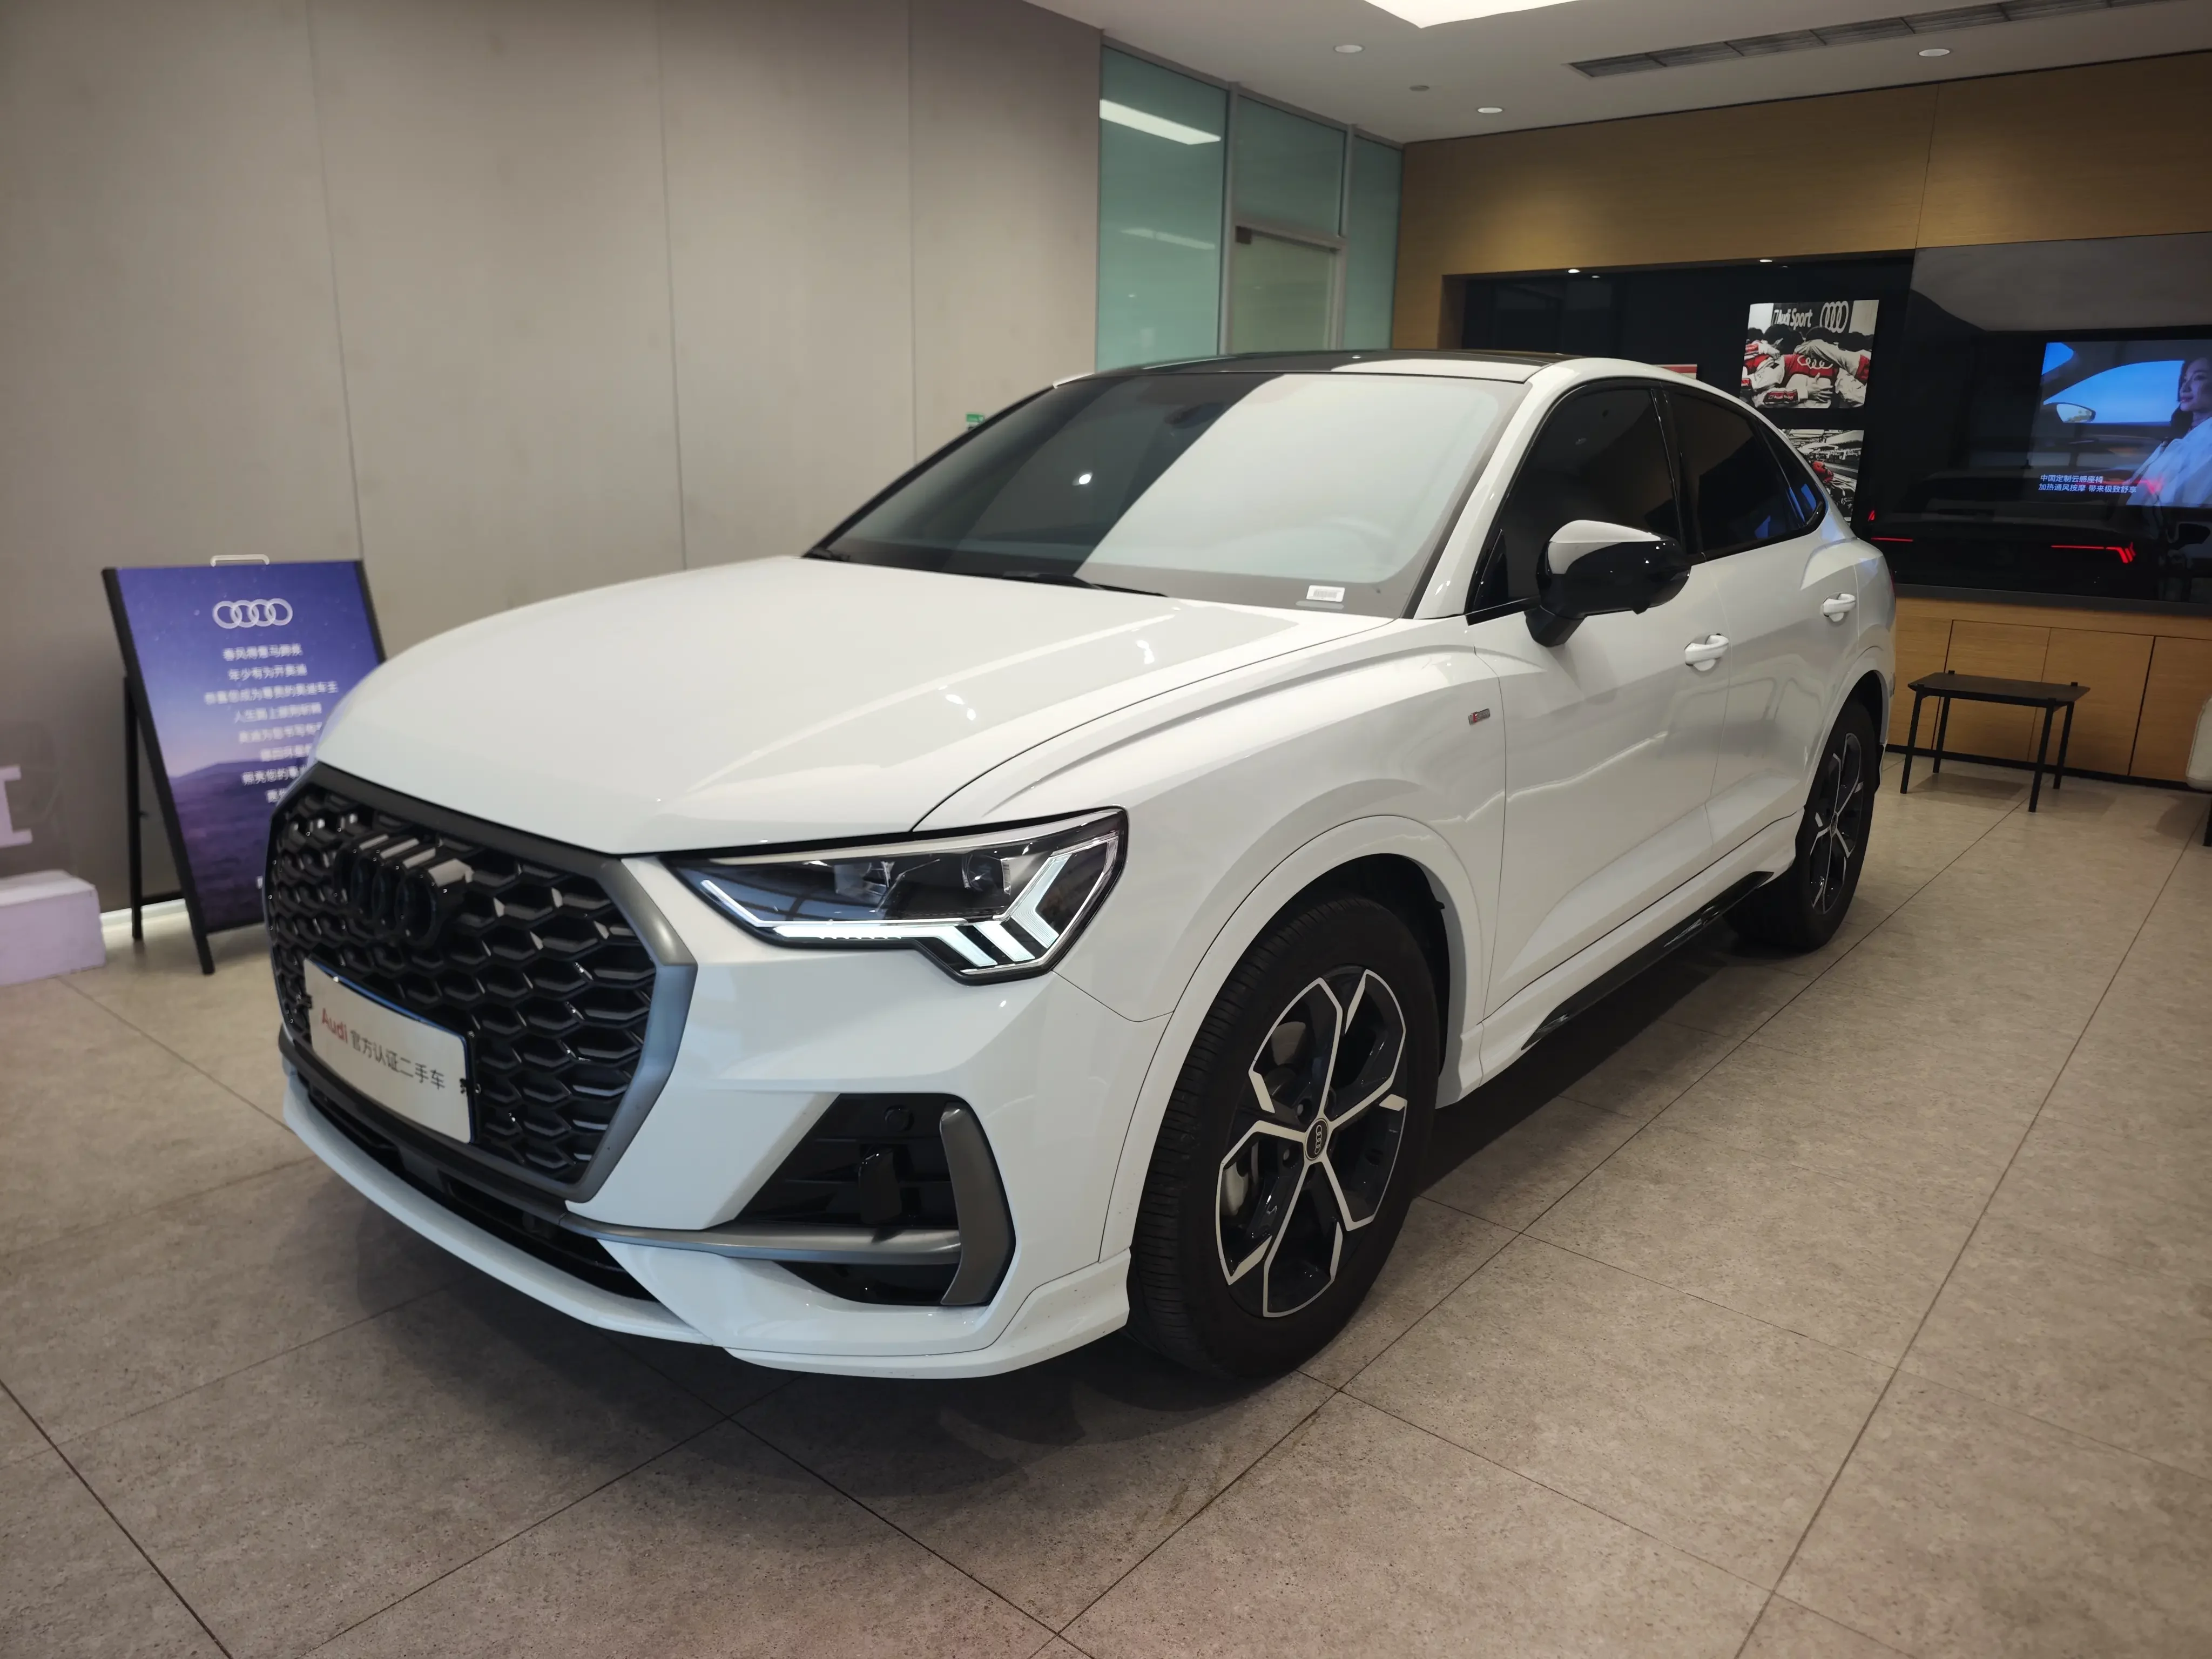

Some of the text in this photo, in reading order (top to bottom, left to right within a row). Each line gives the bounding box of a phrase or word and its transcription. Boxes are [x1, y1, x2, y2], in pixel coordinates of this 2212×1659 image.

[1777, 308, 1813, 331] Audi Sport
[2040, 474, 2103, 483] 中国定制云感座椅
[2038, 483, 2137, 494] 加热通风按摩 带来极致舒享
[321, 1008, 446, 1090] Audi 官方认证二手车
